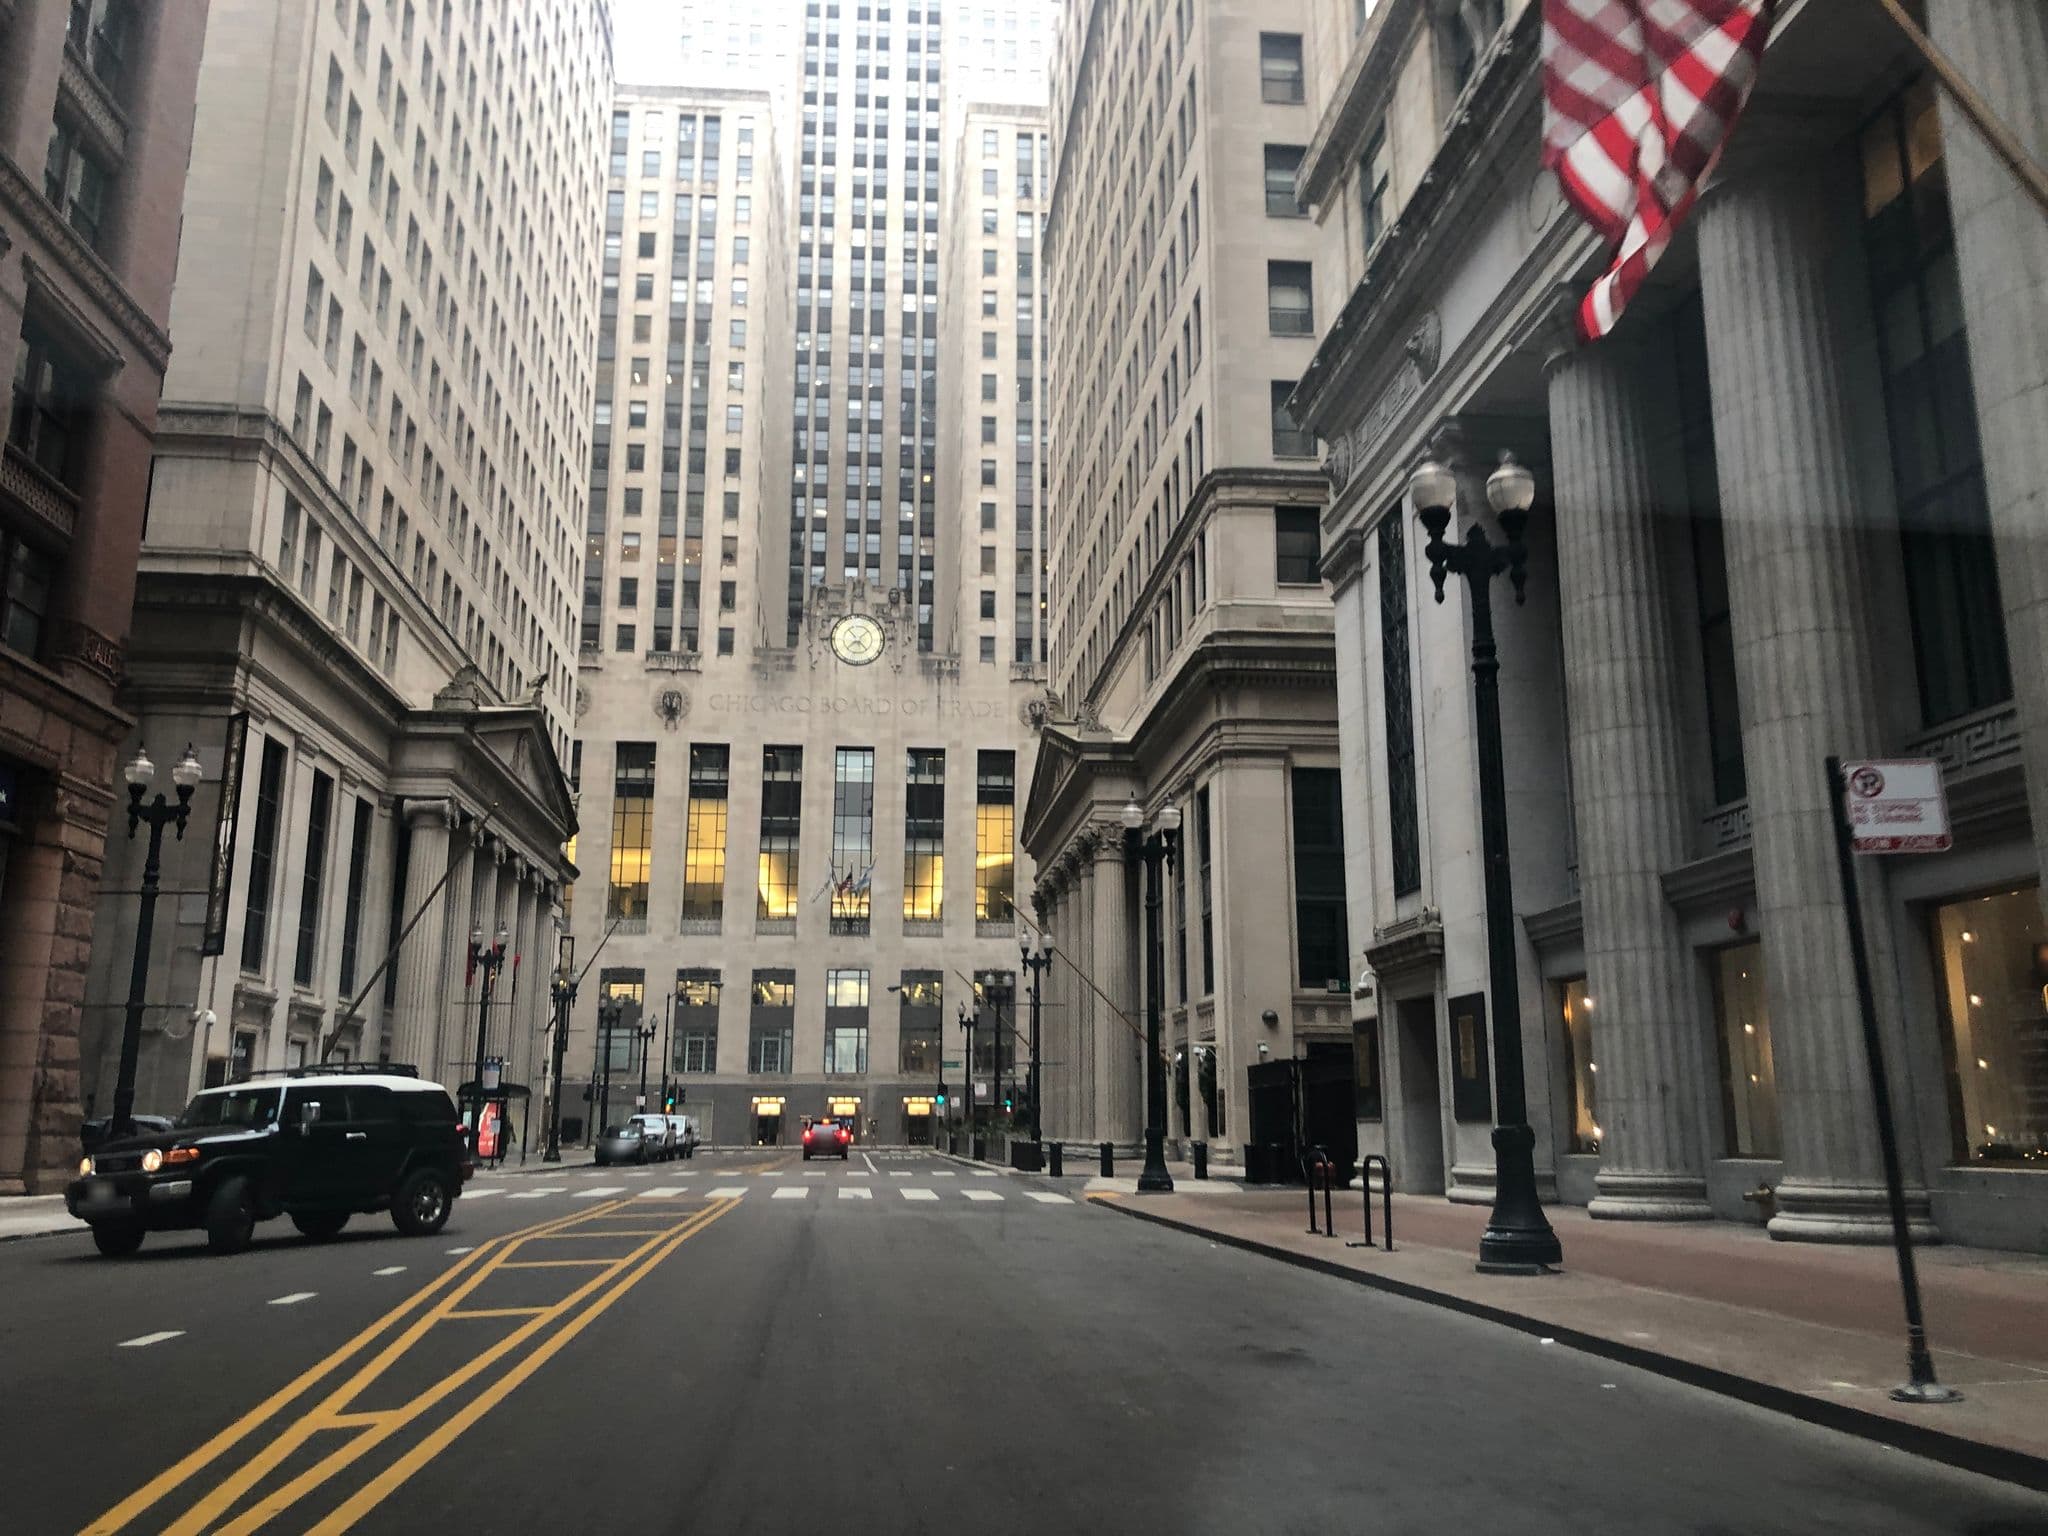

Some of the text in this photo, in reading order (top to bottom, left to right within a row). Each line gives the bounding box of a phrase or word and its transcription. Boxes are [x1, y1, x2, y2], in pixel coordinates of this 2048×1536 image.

[709, 694, 1003, 719] CHICAGO BOARD OF TRADE
